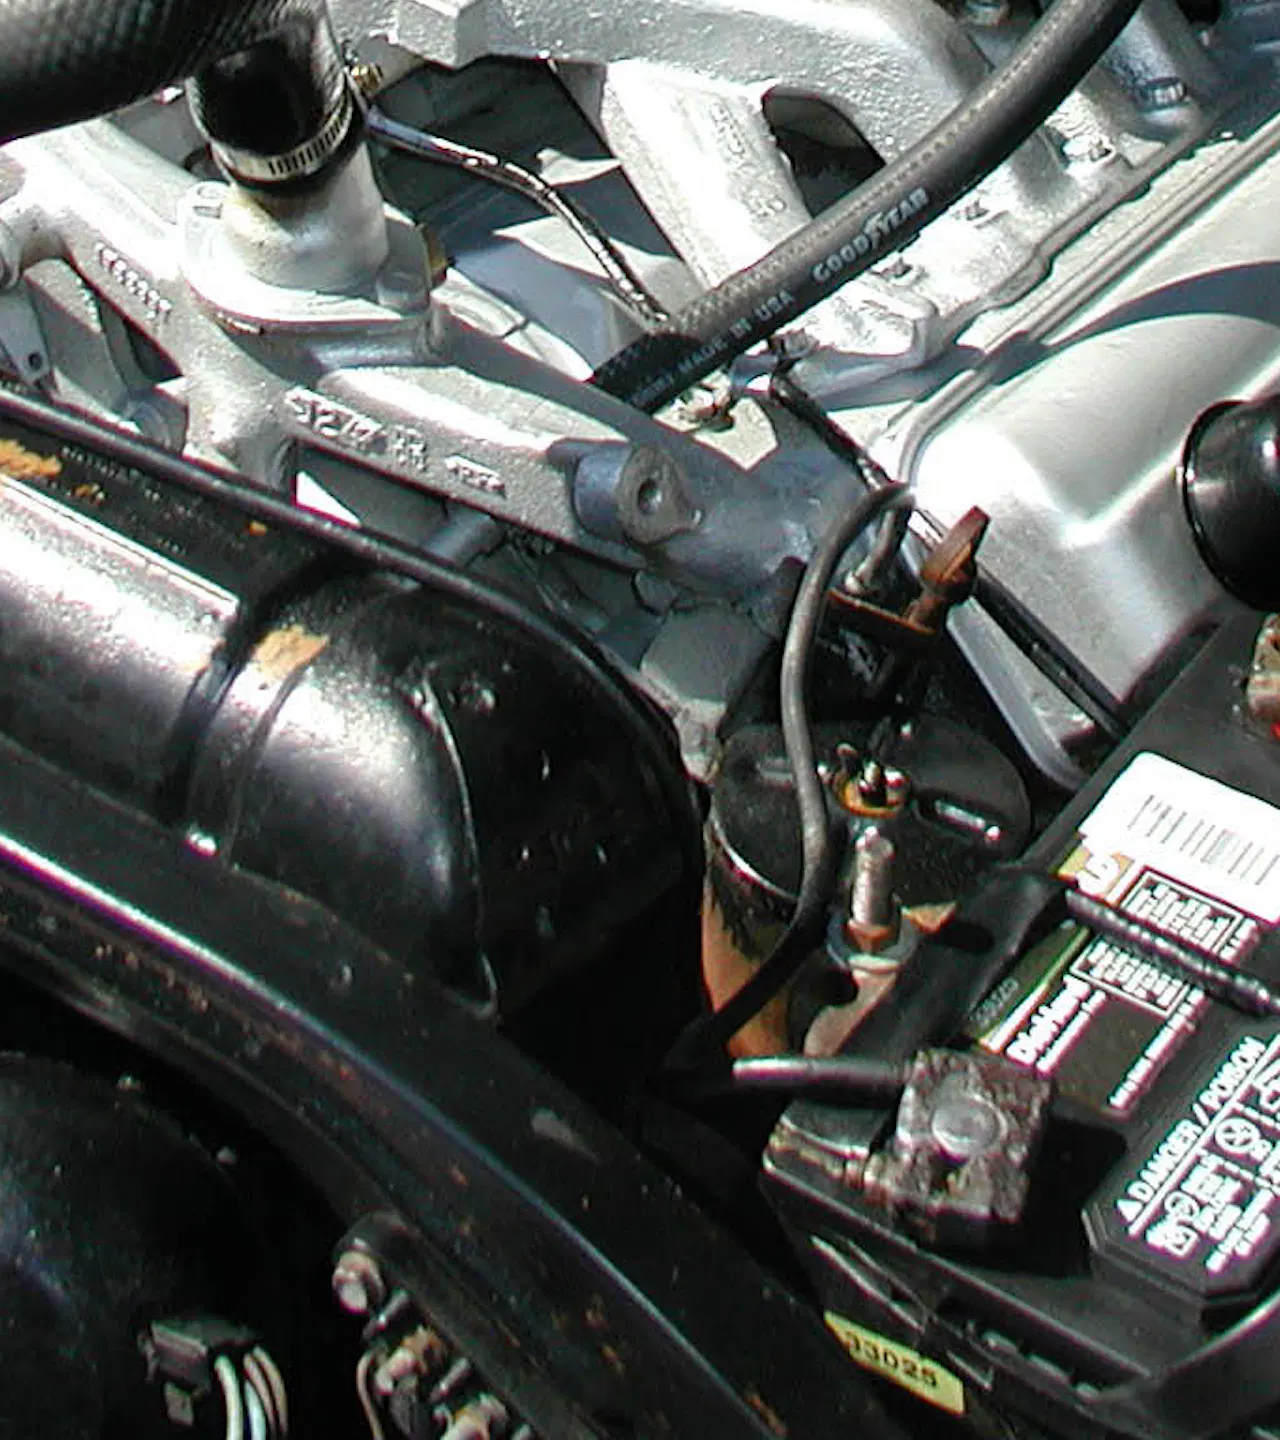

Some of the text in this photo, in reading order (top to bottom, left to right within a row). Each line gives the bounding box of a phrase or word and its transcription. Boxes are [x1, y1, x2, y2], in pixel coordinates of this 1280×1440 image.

[811, 187, 929, 283] GOODYEAR
[754, 289, 795, 321] USA
[1127, 1119, 1203, 1202] DANGER
[1199, 1036, 1266, 1110] POISON
